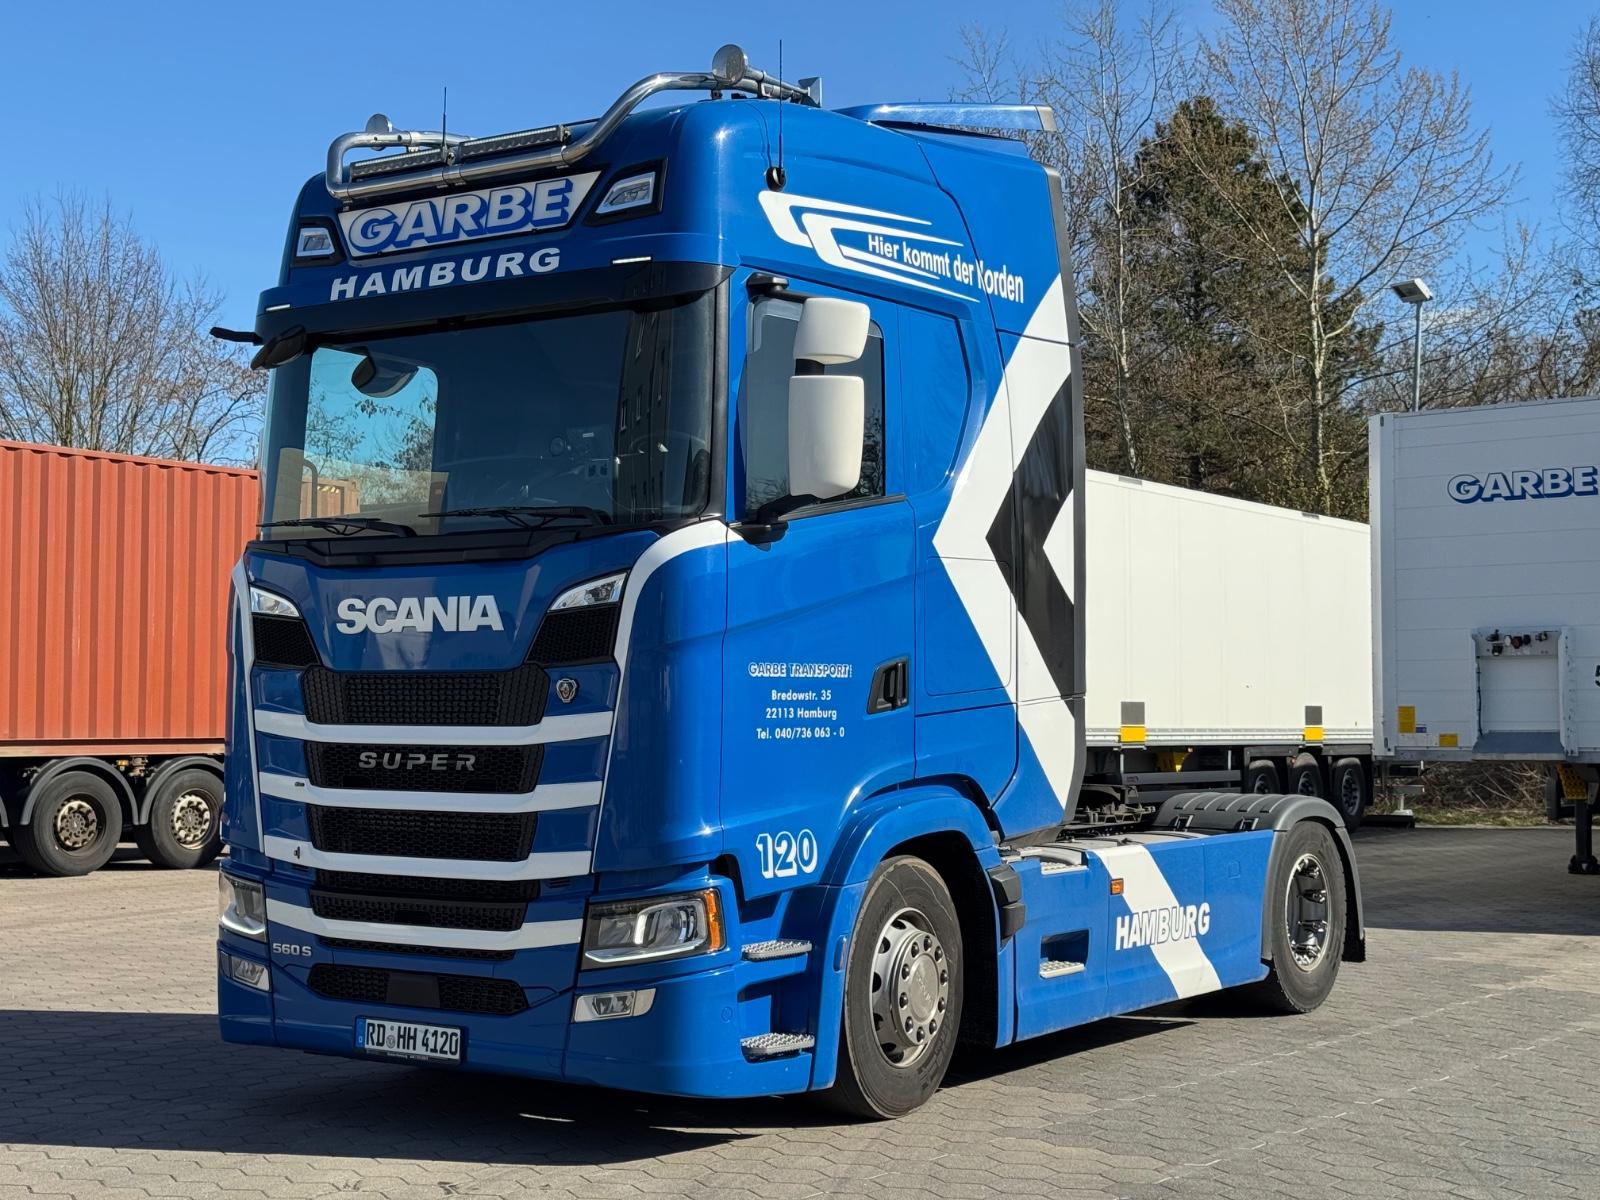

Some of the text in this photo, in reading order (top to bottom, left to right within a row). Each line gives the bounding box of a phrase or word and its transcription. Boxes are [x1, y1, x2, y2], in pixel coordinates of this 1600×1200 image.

[349, 178, 574, 254] GARBE
[330, 247, 561, 301] HAMBURG
[868, 234, 1024, 304] Hier kommt der Norden
[1447, 466, 1598, 504] GARBE
[336, 595, 505, 634] SCANIA
[748, 662, 787, 678] GARBE
[788, 663, 850, 678] TRANSPORT
[771, 689, 832, 701] Bredowstr. 35
[765, 706, 837, 721] 22113 Hamburg
[756, 727, 772, 739] Tel.
[774, 727, 812, 740] 040/736
[814, 727, 831, 738] 063
[839, 726, 845, 738] 0
[358, 752, 476, 771] SUPER
[755, 828, 818, 879] 120
[1115, 902, 1211, 951] HAMBURG
[272, 942, 312, 957] 560 S
[366, 1022, 459, 1056] RD HH 4120
